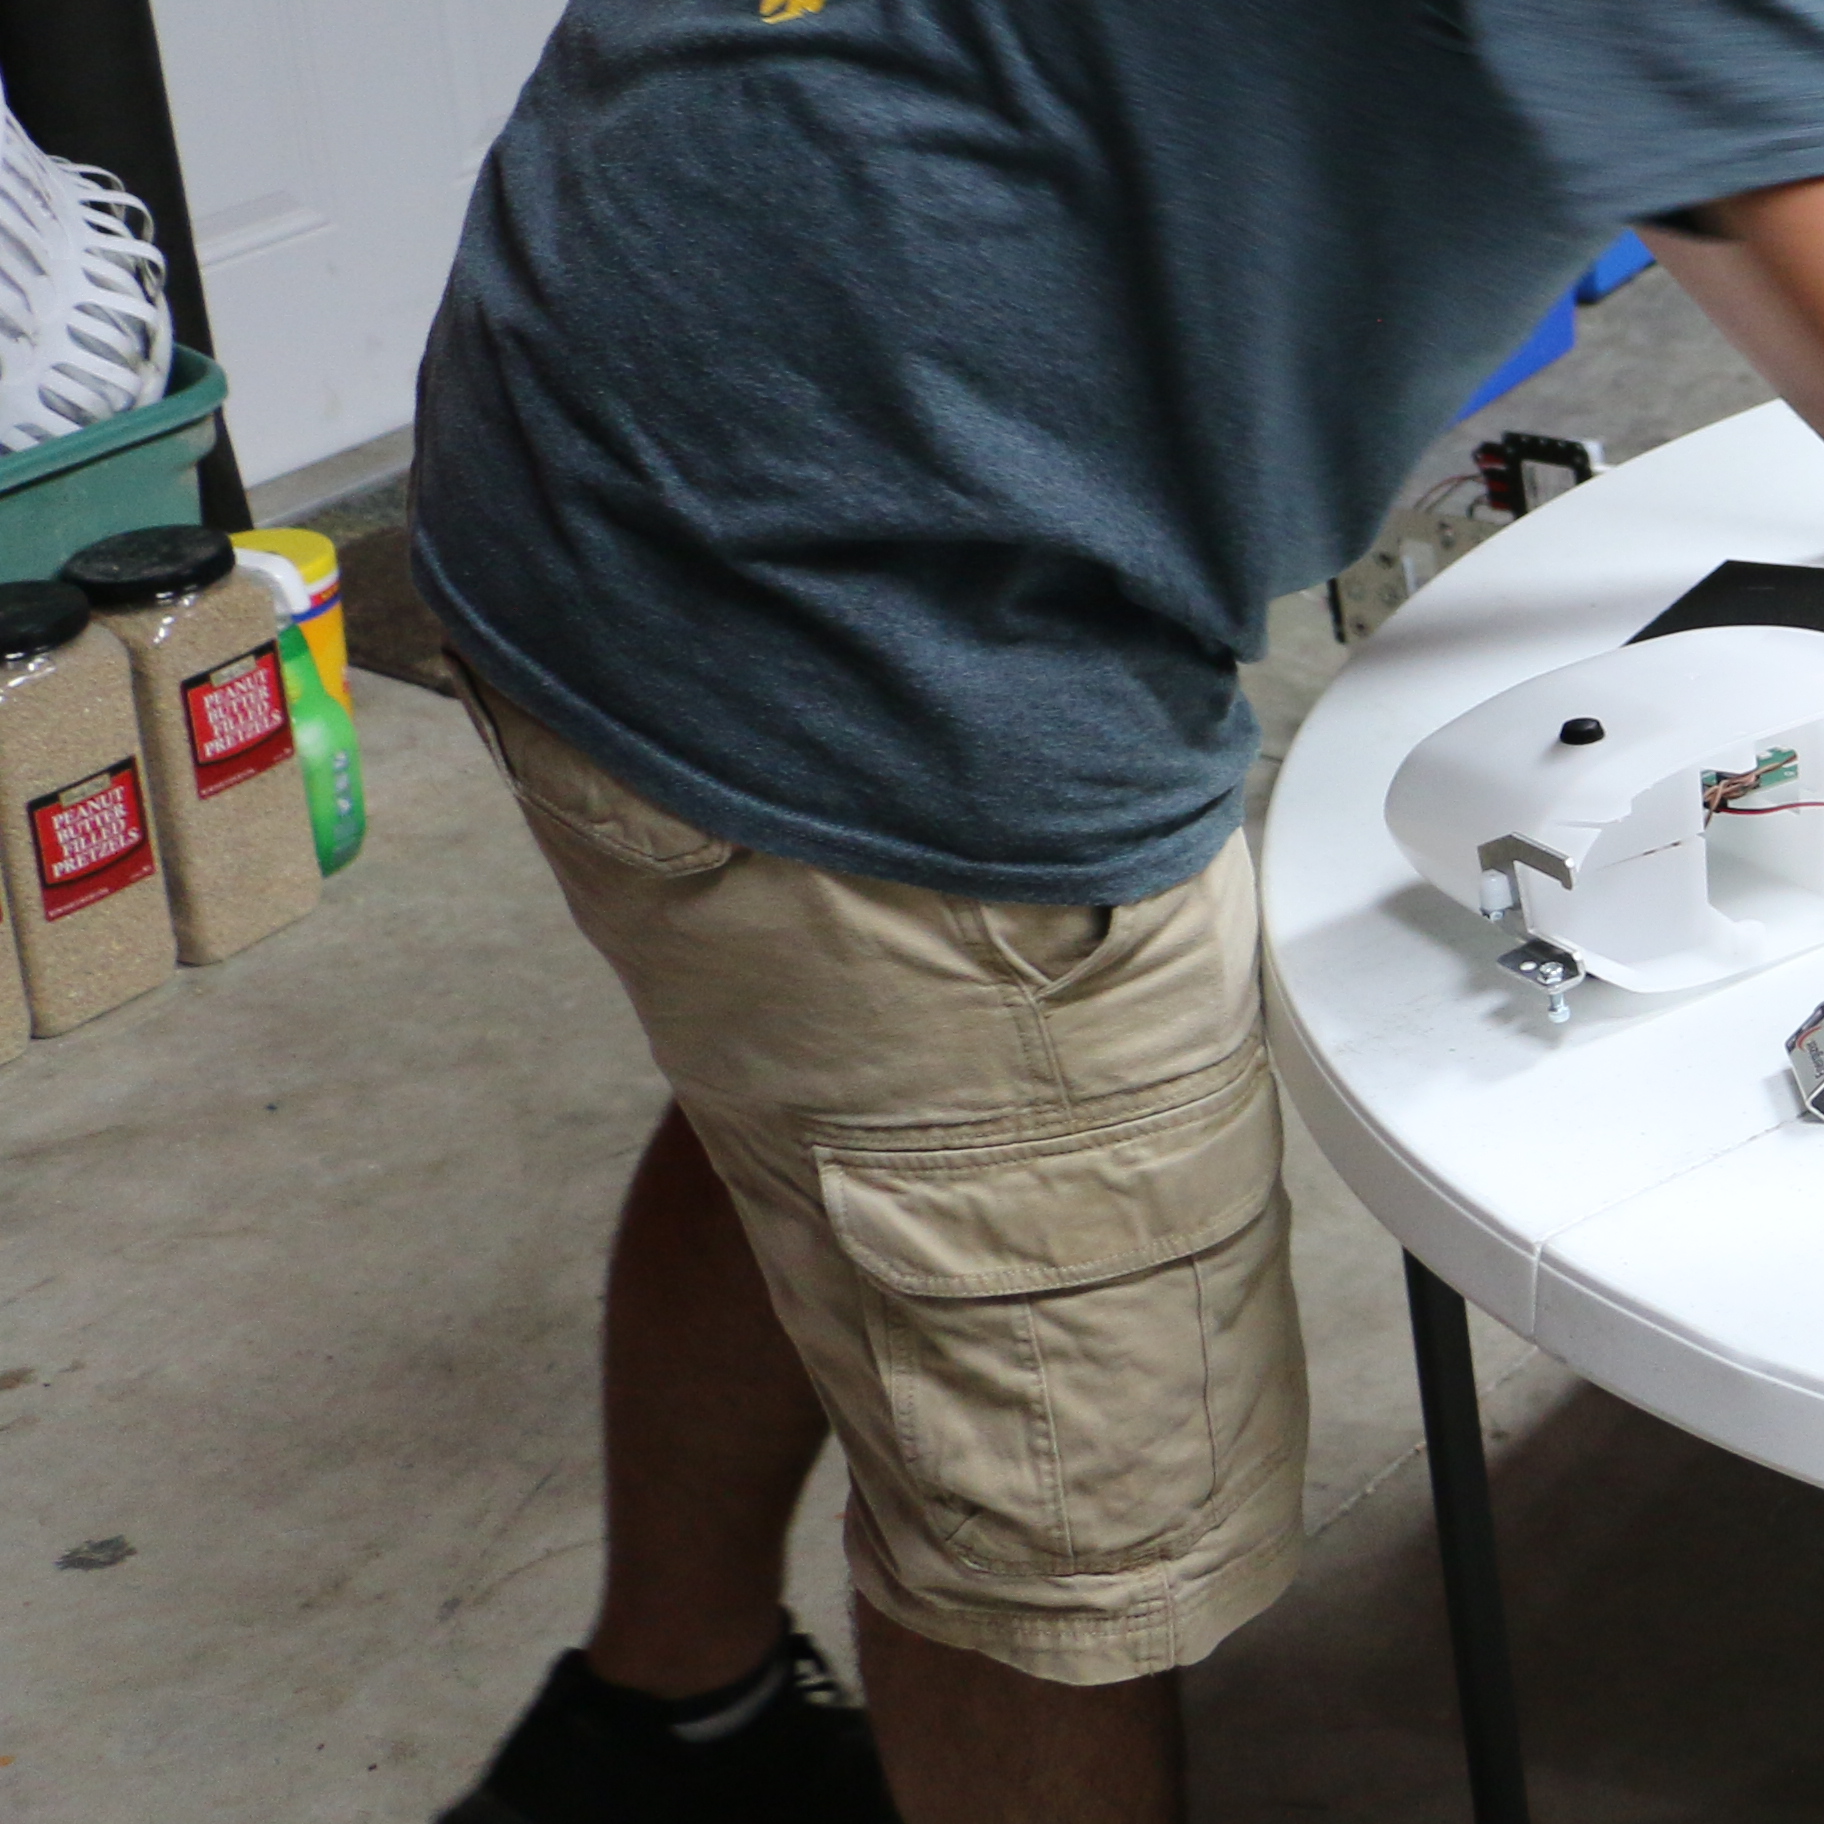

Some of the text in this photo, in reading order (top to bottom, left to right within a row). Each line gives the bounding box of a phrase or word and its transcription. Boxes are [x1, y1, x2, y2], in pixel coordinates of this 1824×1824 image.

[203, 668, 268, 709] PEANUT
[207, 685, 269, 723] BUTTER
[203, 709, 283, 757] PRETZELS
[213, 700, 269, 737] FILLED
[52, 786, 124, 829] PEANUT
[56, 803, 127, 843] BUTTER
[52, 827, 141, 878] PRETZELS
[62, 819, 126, 857] FILLED
